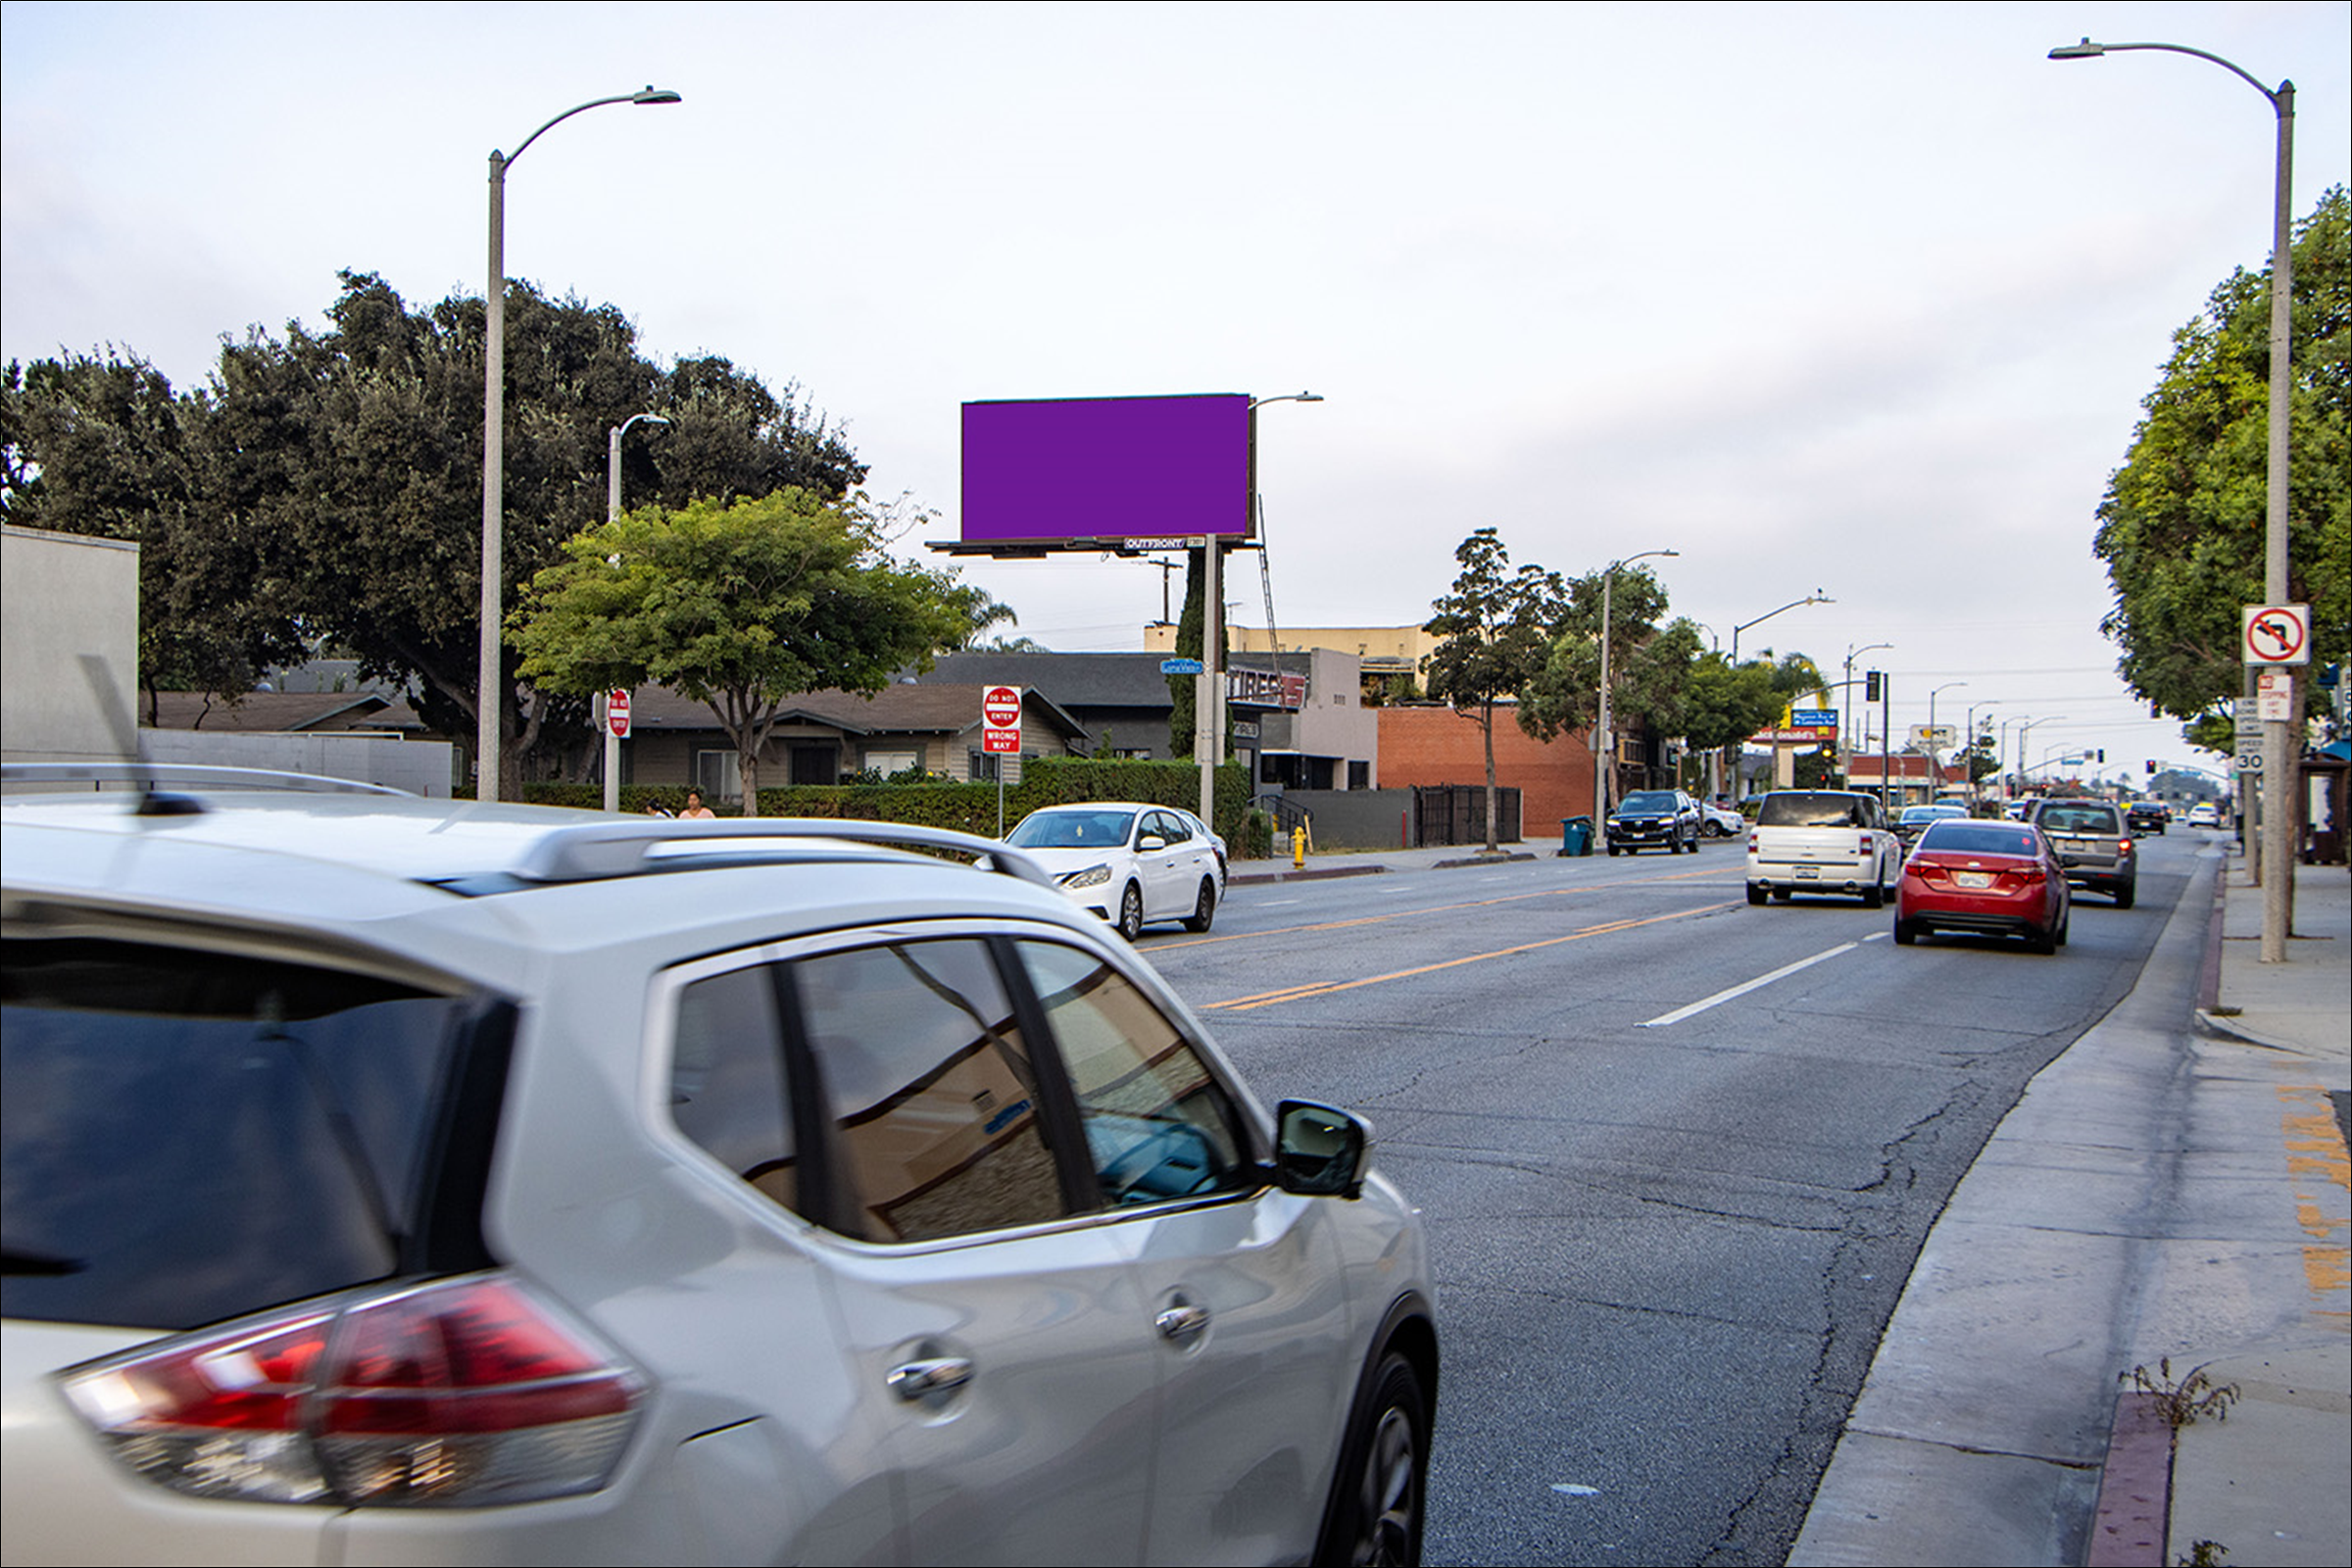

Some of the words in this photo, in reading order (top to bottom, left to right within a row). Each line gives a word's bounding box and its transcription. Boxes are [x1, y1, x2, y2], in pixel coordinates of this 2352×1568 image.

[1125, 538, 1185, 549] OUTFRONT
[1226, 668, 1282, 704] TIRES
[987, 731, 1017, 741] WRONG
[1752, 729, 1816, 740] conald's
[993, 741, 1010, 750] WAY
[2238, 755, 2263, 768] 30
